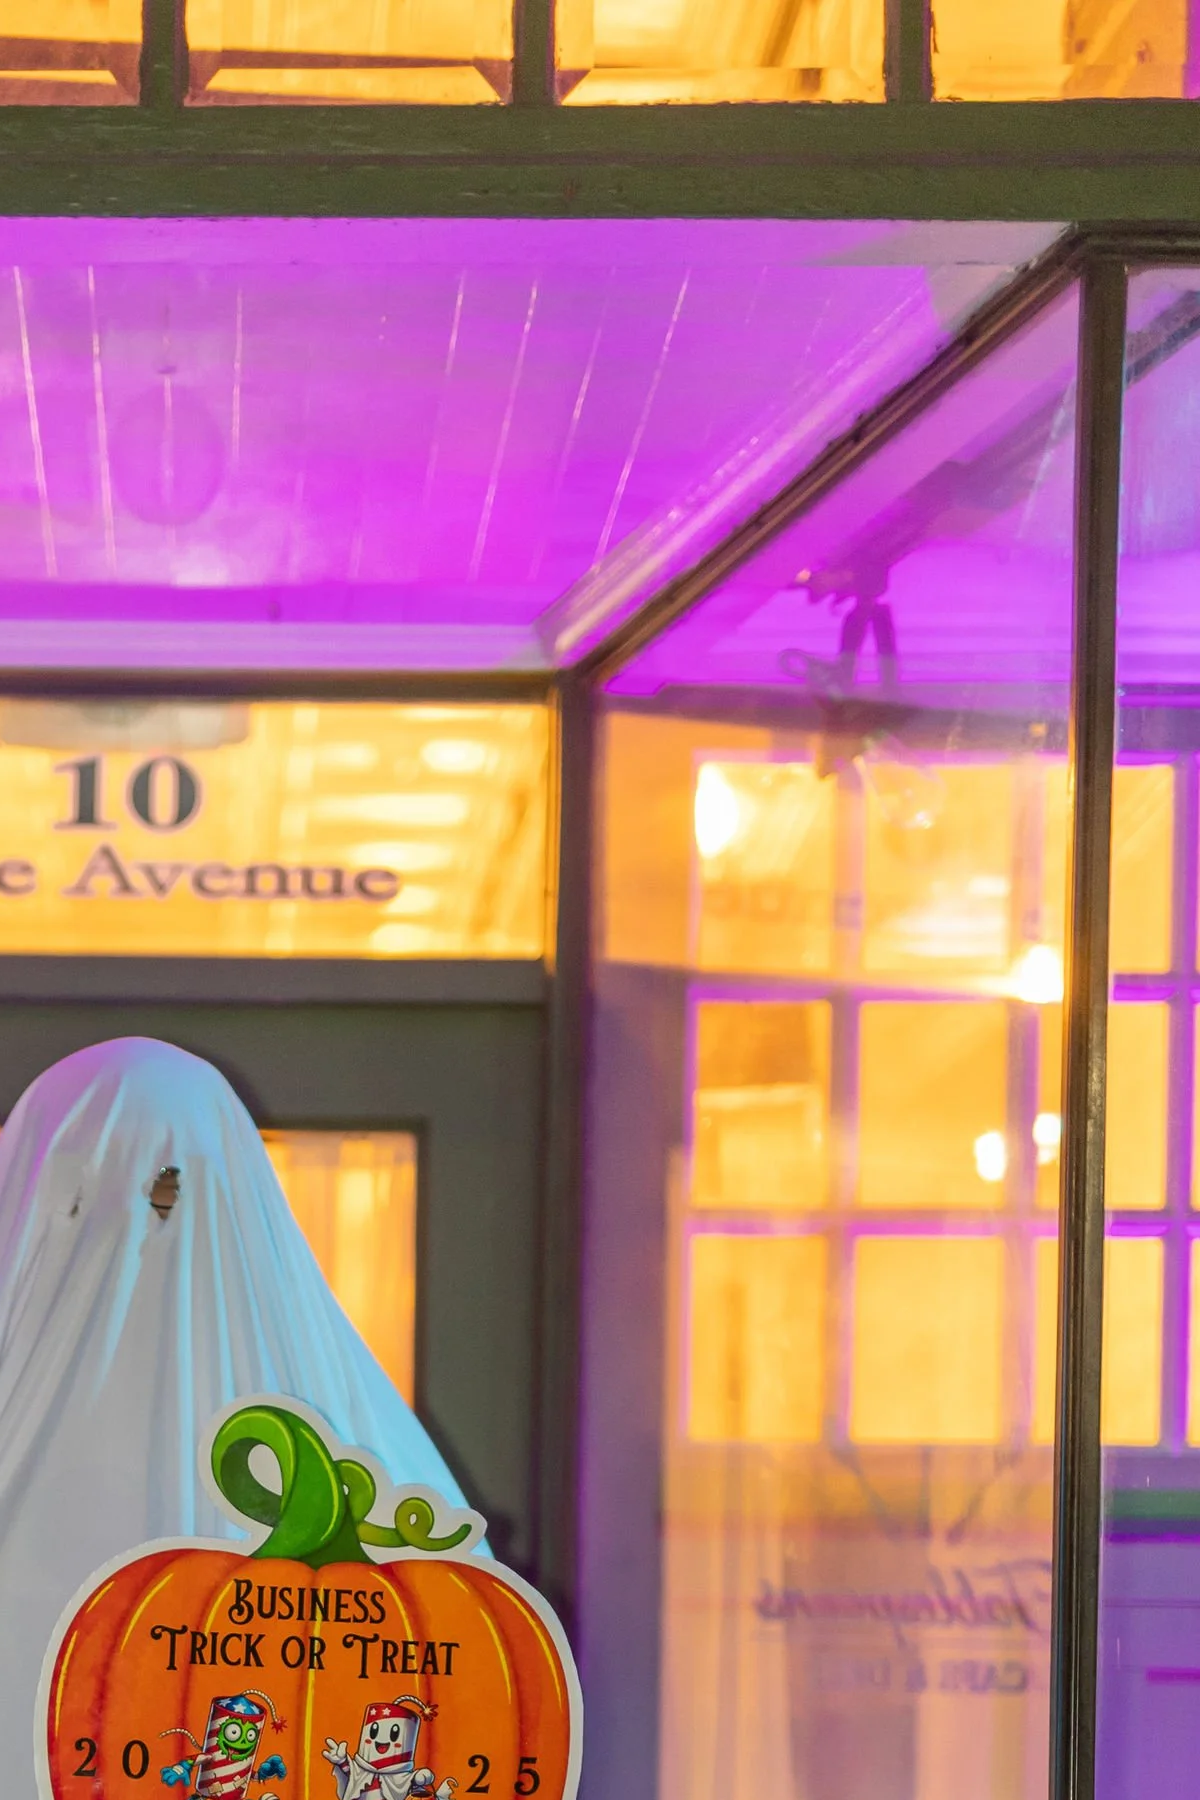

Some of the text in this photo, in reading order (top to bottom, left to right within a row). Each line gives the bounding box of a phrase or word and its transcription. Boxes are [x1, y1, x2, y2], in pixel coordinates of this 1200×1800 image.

[54, 754, 204, 833] 10
[60, 842, 401, 901] Avenue
[228, 1578, 386, 1625] BUSINESS
[150, 1625, 460, 1679] TRICK OR TREAT
